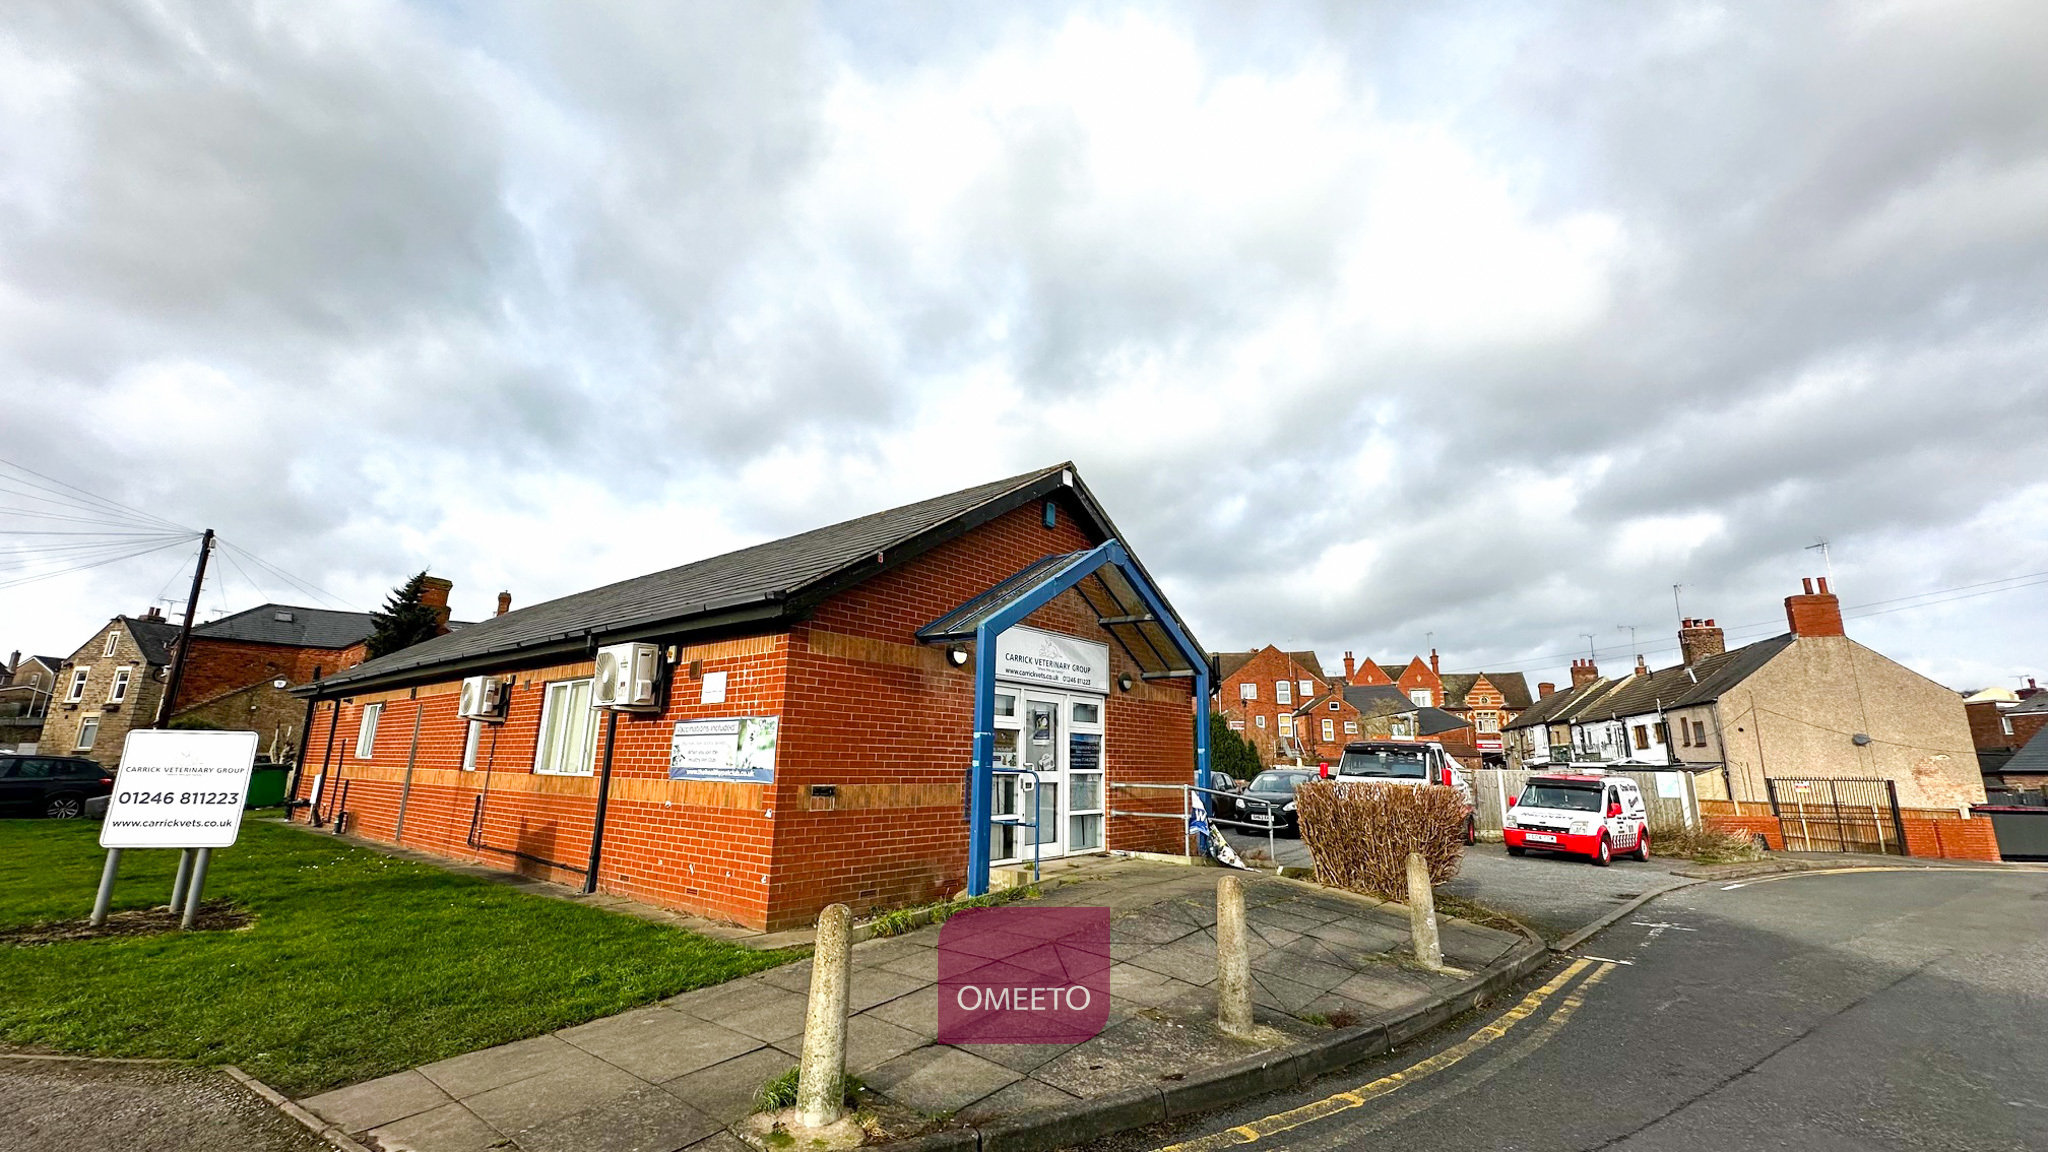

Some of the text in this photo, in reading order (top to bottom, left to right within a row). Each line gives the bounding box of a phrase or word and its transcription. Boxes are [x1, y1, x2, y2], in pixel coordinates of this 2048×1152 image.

[1005, 653, 1033, 665] CARRICK
[1034, 658, 1071, 670] VETERINARY
[1071, 664, 1091, 674] GROUP
[1005, 668, 1059, 681] www.carrickvets.co.uk
[118, 792, 239, 805] 01246 811223
[112, 819, 232, 828] www.carrickvets.co.uk
